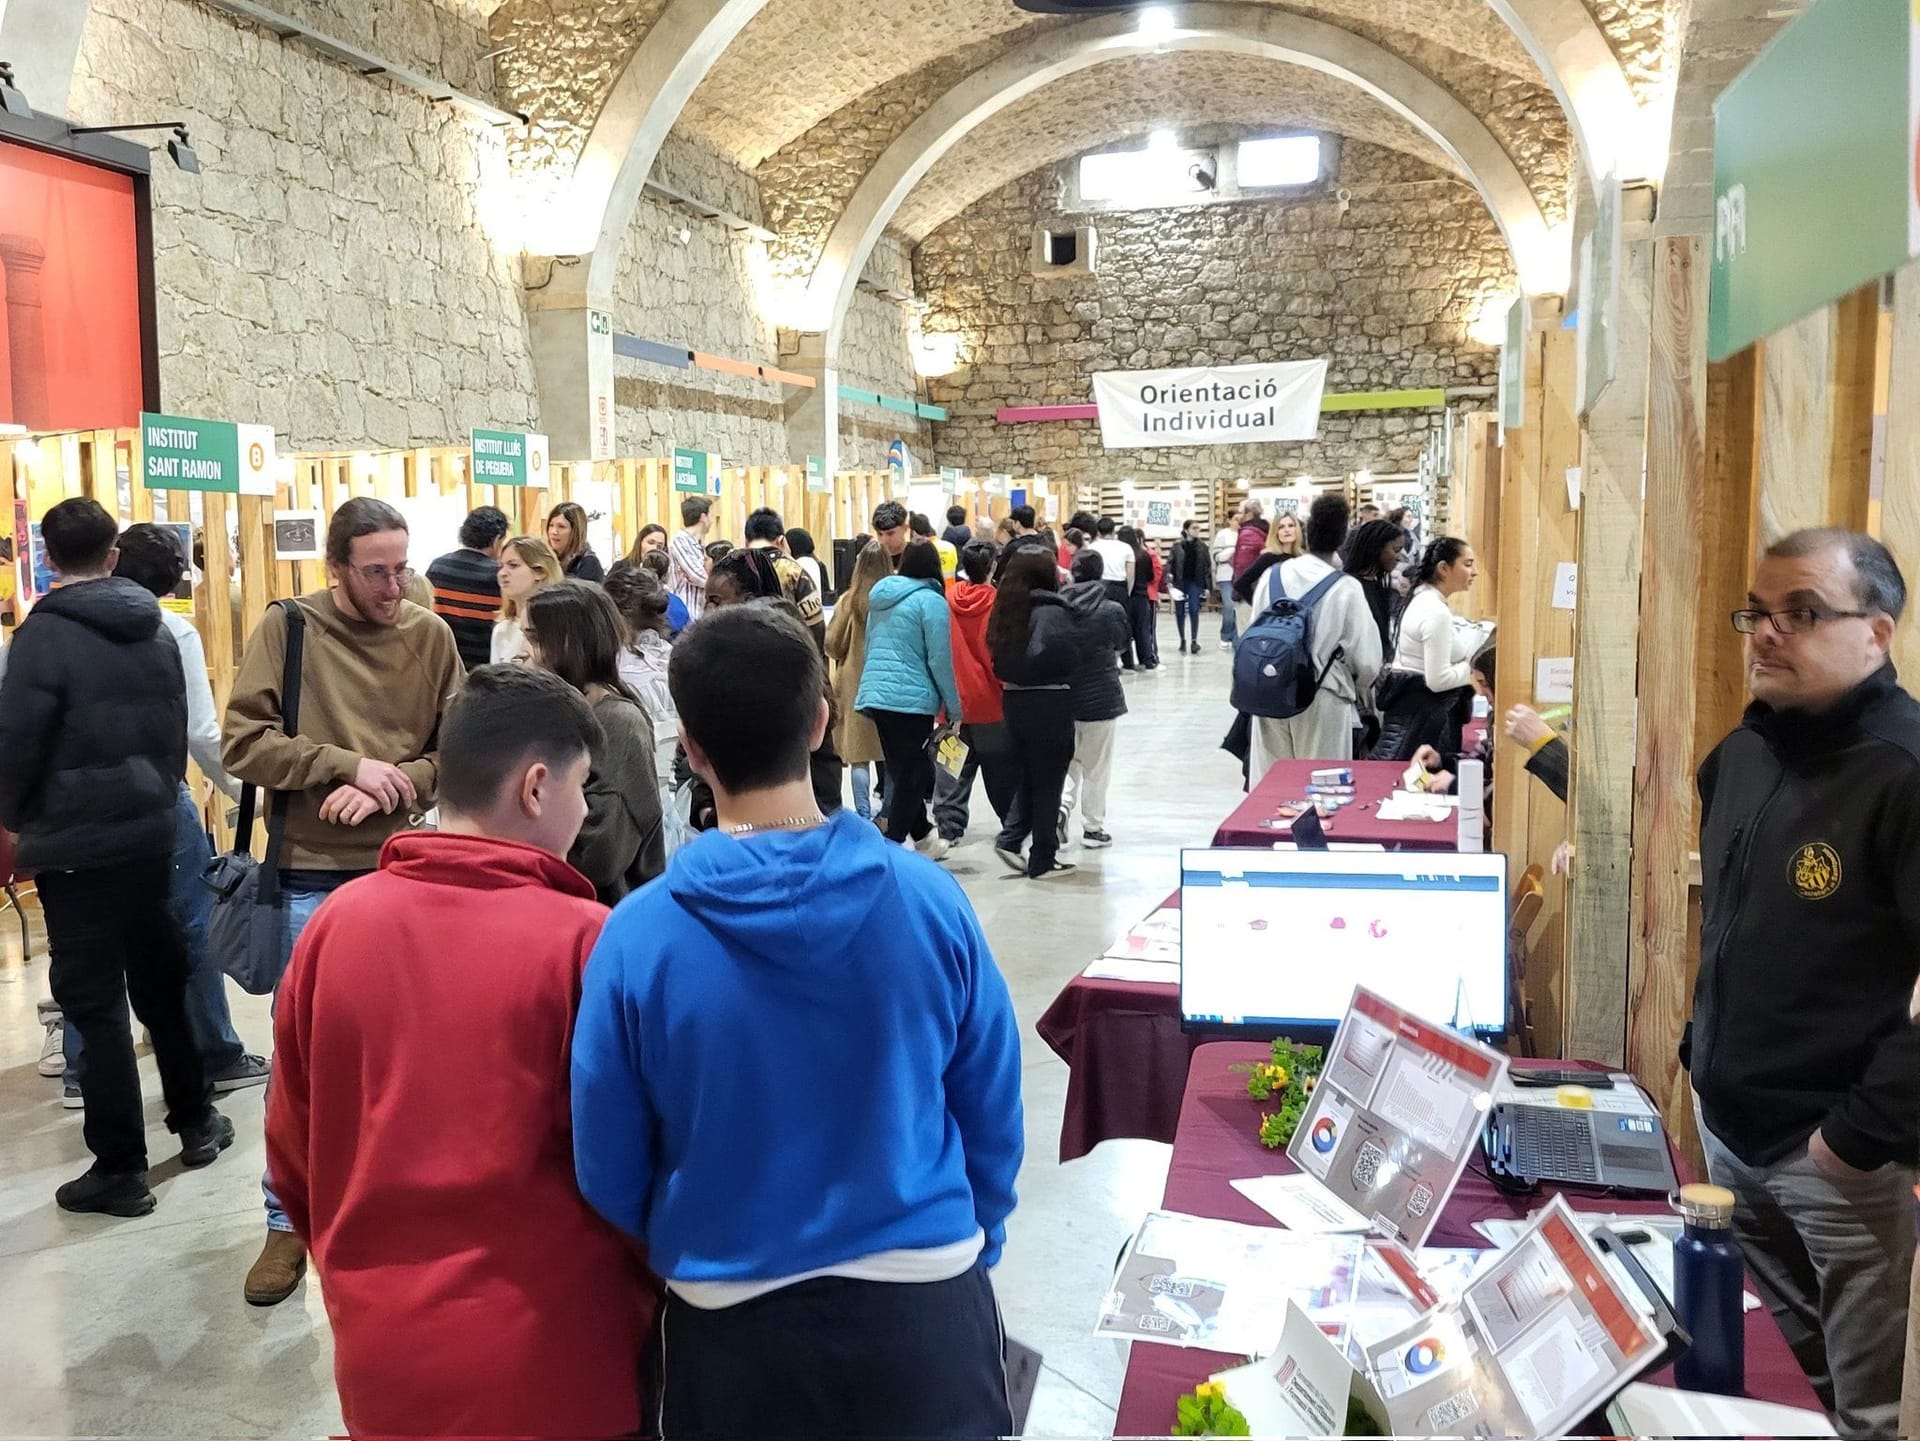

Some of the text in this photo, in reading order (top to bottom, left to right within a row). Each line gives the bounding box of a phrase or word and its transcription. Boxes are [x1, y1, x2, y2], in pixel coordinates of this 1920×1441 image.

[1140, 377, 1277, 404] Orientació
[1143, 406, 1274, 432] Individual
[147, 427, 198, 450] INSTITUT
[474, 438, 522, 457] INSTITUT LLUÍS
[148, 456, 221, 480] SANT RAMON
[475, 460, 514, 477] DE PEGUERA
